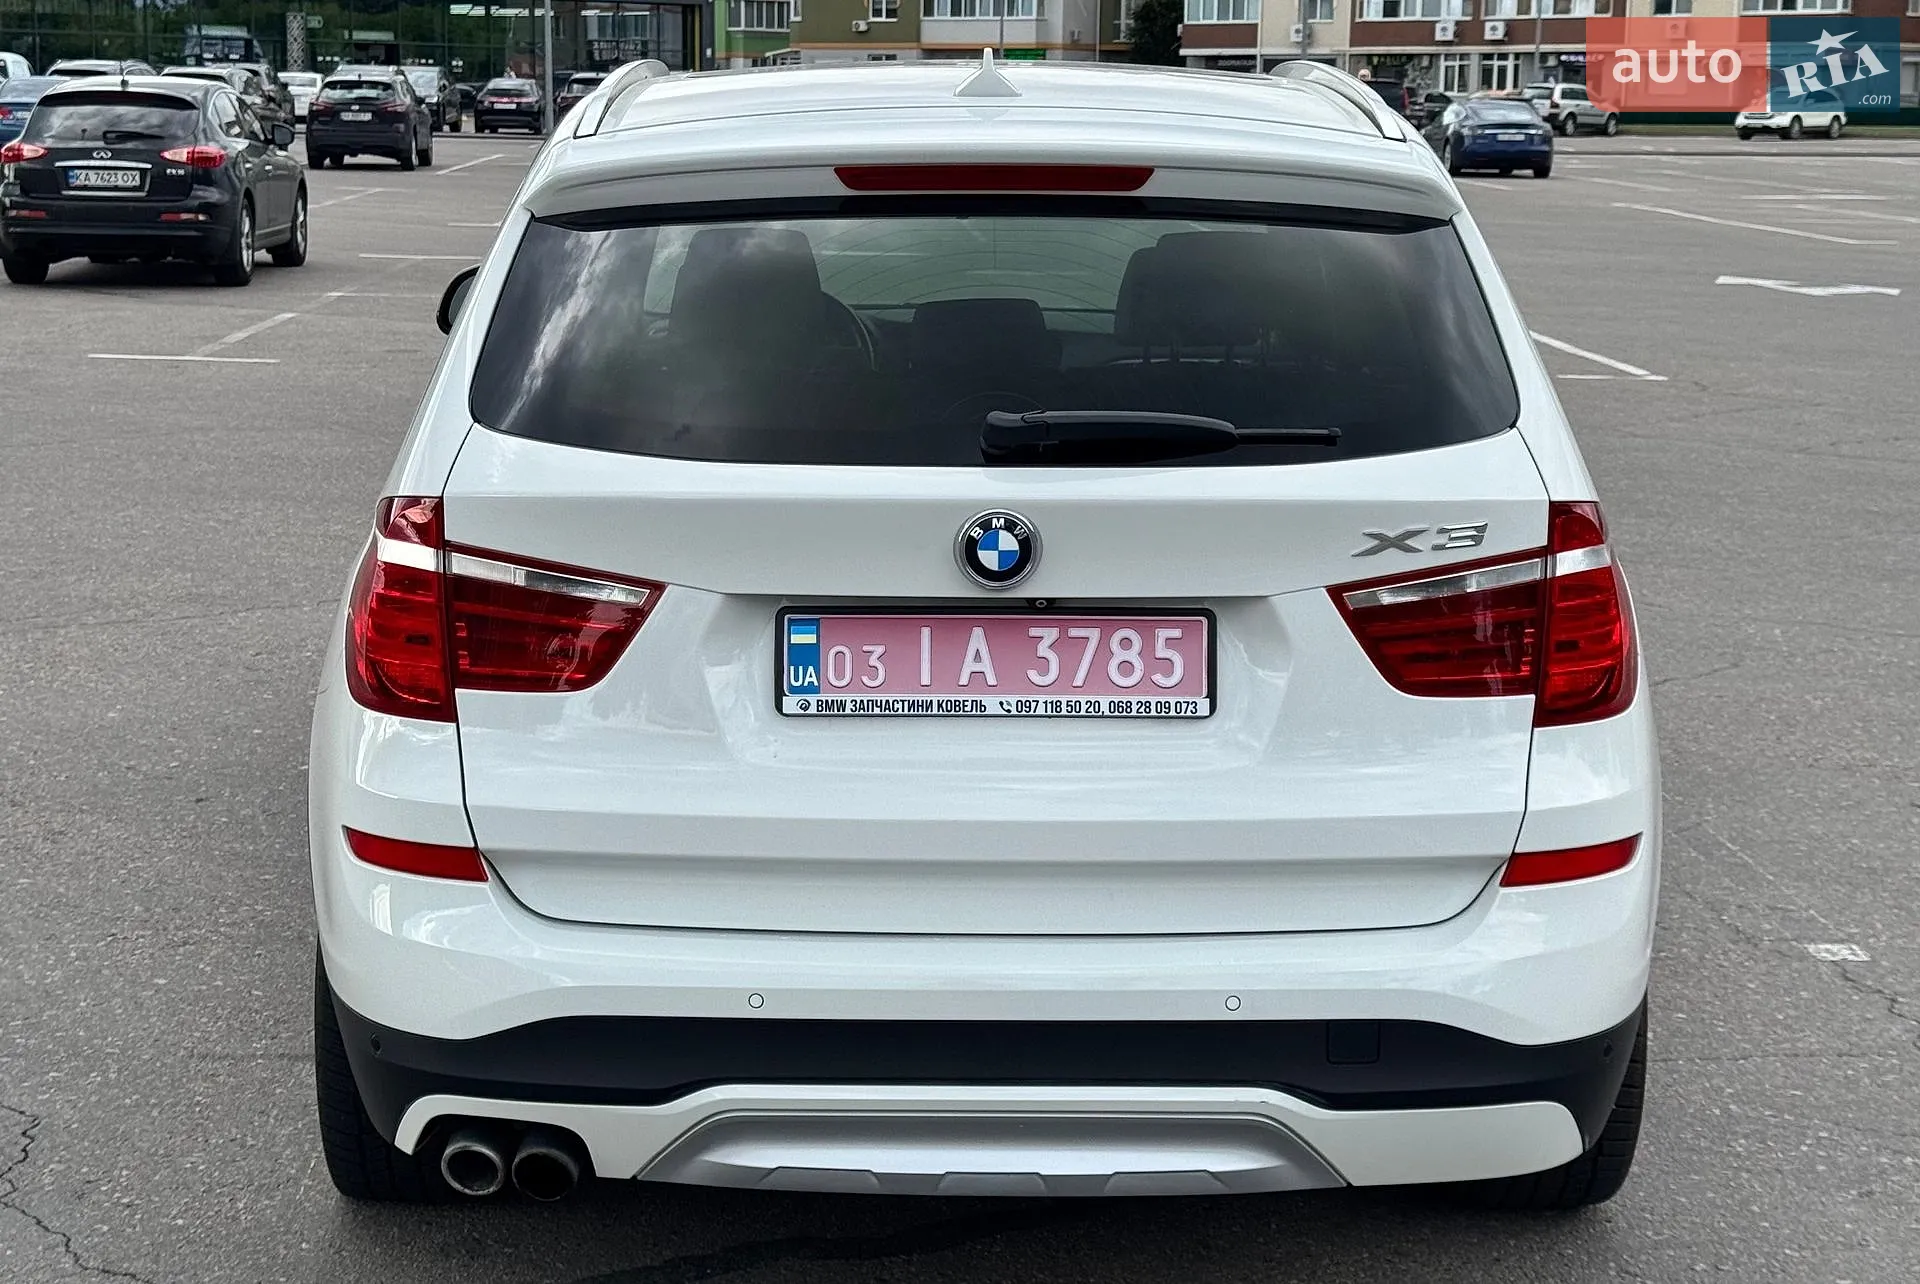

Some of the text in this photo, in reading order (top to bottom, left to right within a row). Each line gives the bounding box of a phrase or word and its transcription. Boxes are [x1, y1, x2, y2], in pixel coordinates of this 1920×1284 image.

[75, 171, 138, 185] KA 7623 OX
[970, 517, 1028, 540] BMW
[1351, 521, 1489, 557] X3
[827, 625, 1185, 689] 03 IA 3785
[790, 665, 819, 687] UA
[816, 699, 1199, 717] BMW ЗАПЧАСТИНИ КОВЕЛЬ 097 118 50 20, 068 28 09 073
